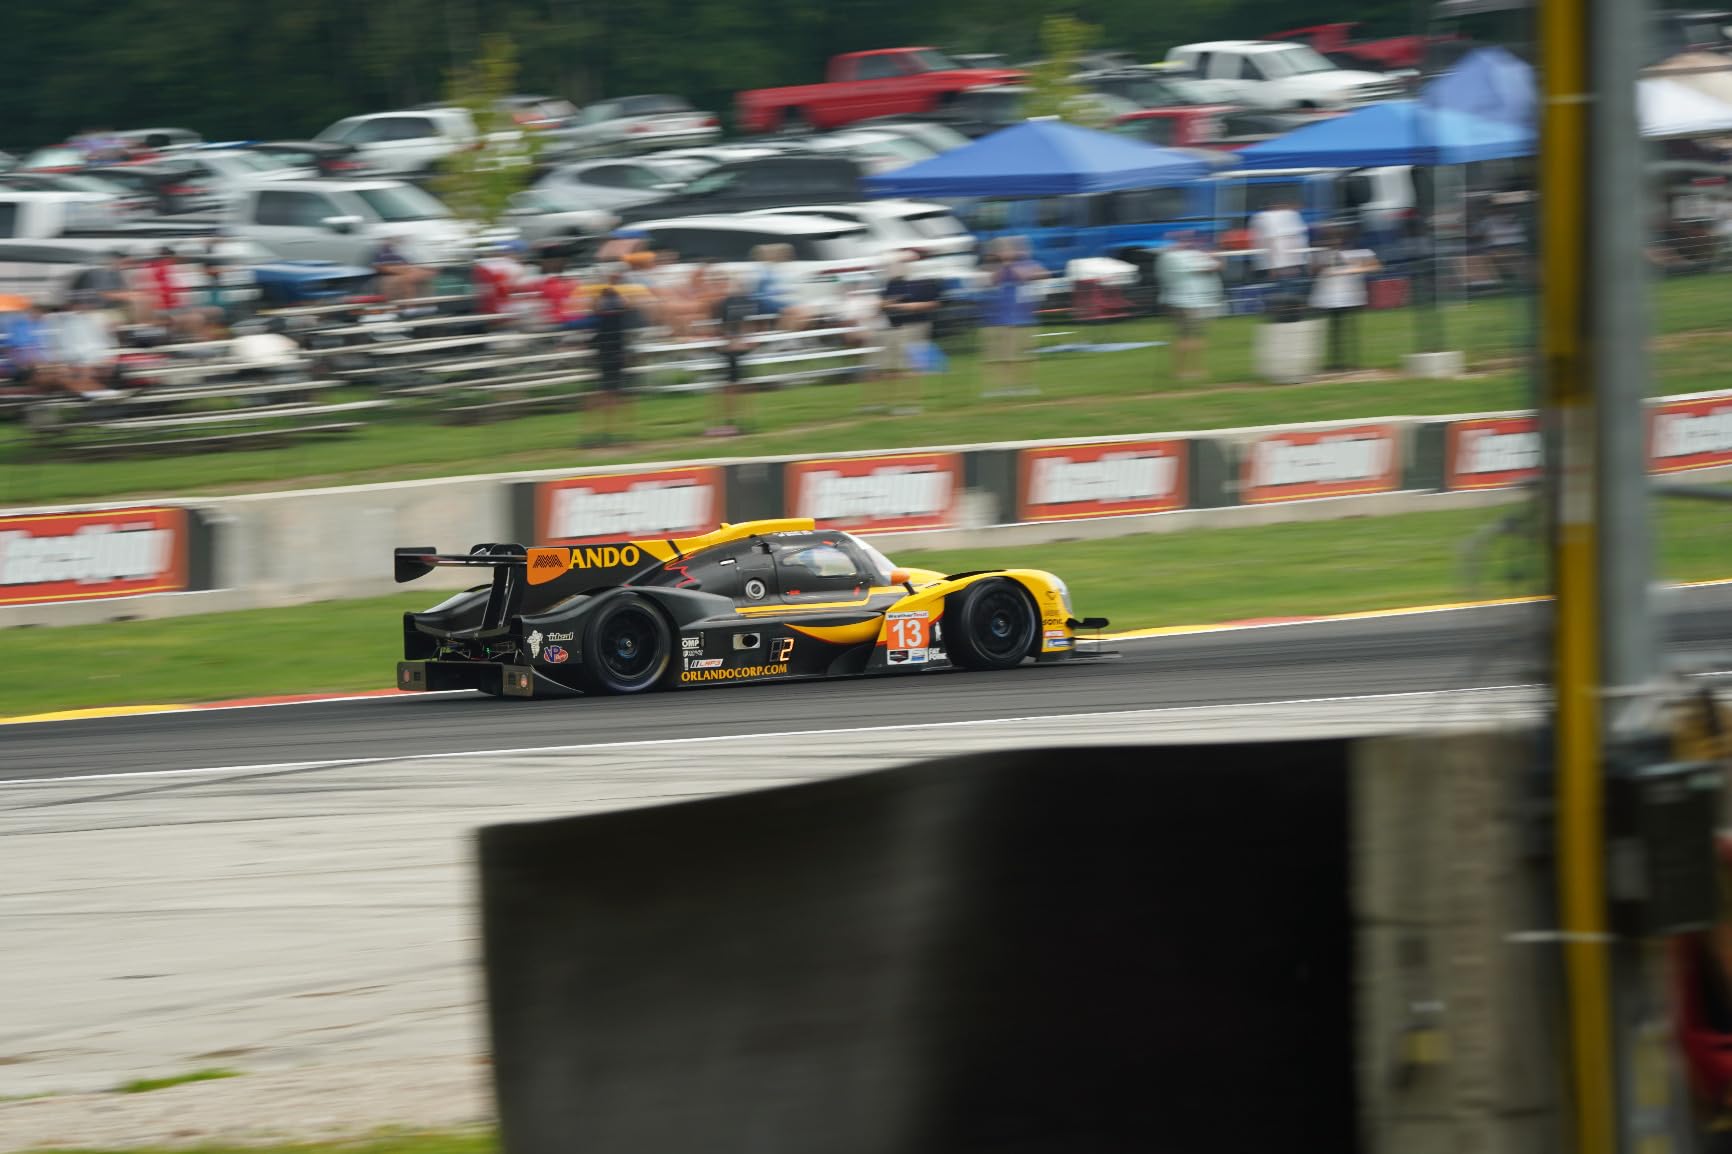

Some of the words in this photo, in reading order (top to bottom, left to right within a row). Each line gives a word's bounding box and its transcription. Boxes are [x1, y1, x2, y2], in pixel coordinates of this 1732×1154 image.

[569, 545, 640, 570] ANDO
[892, 619, 923, 648] 13
[681, 639, 699, 648] OMP
[544, 645, 561, 663] VP
[681, 664, 788, 682] ORLANDOCORP.COM
